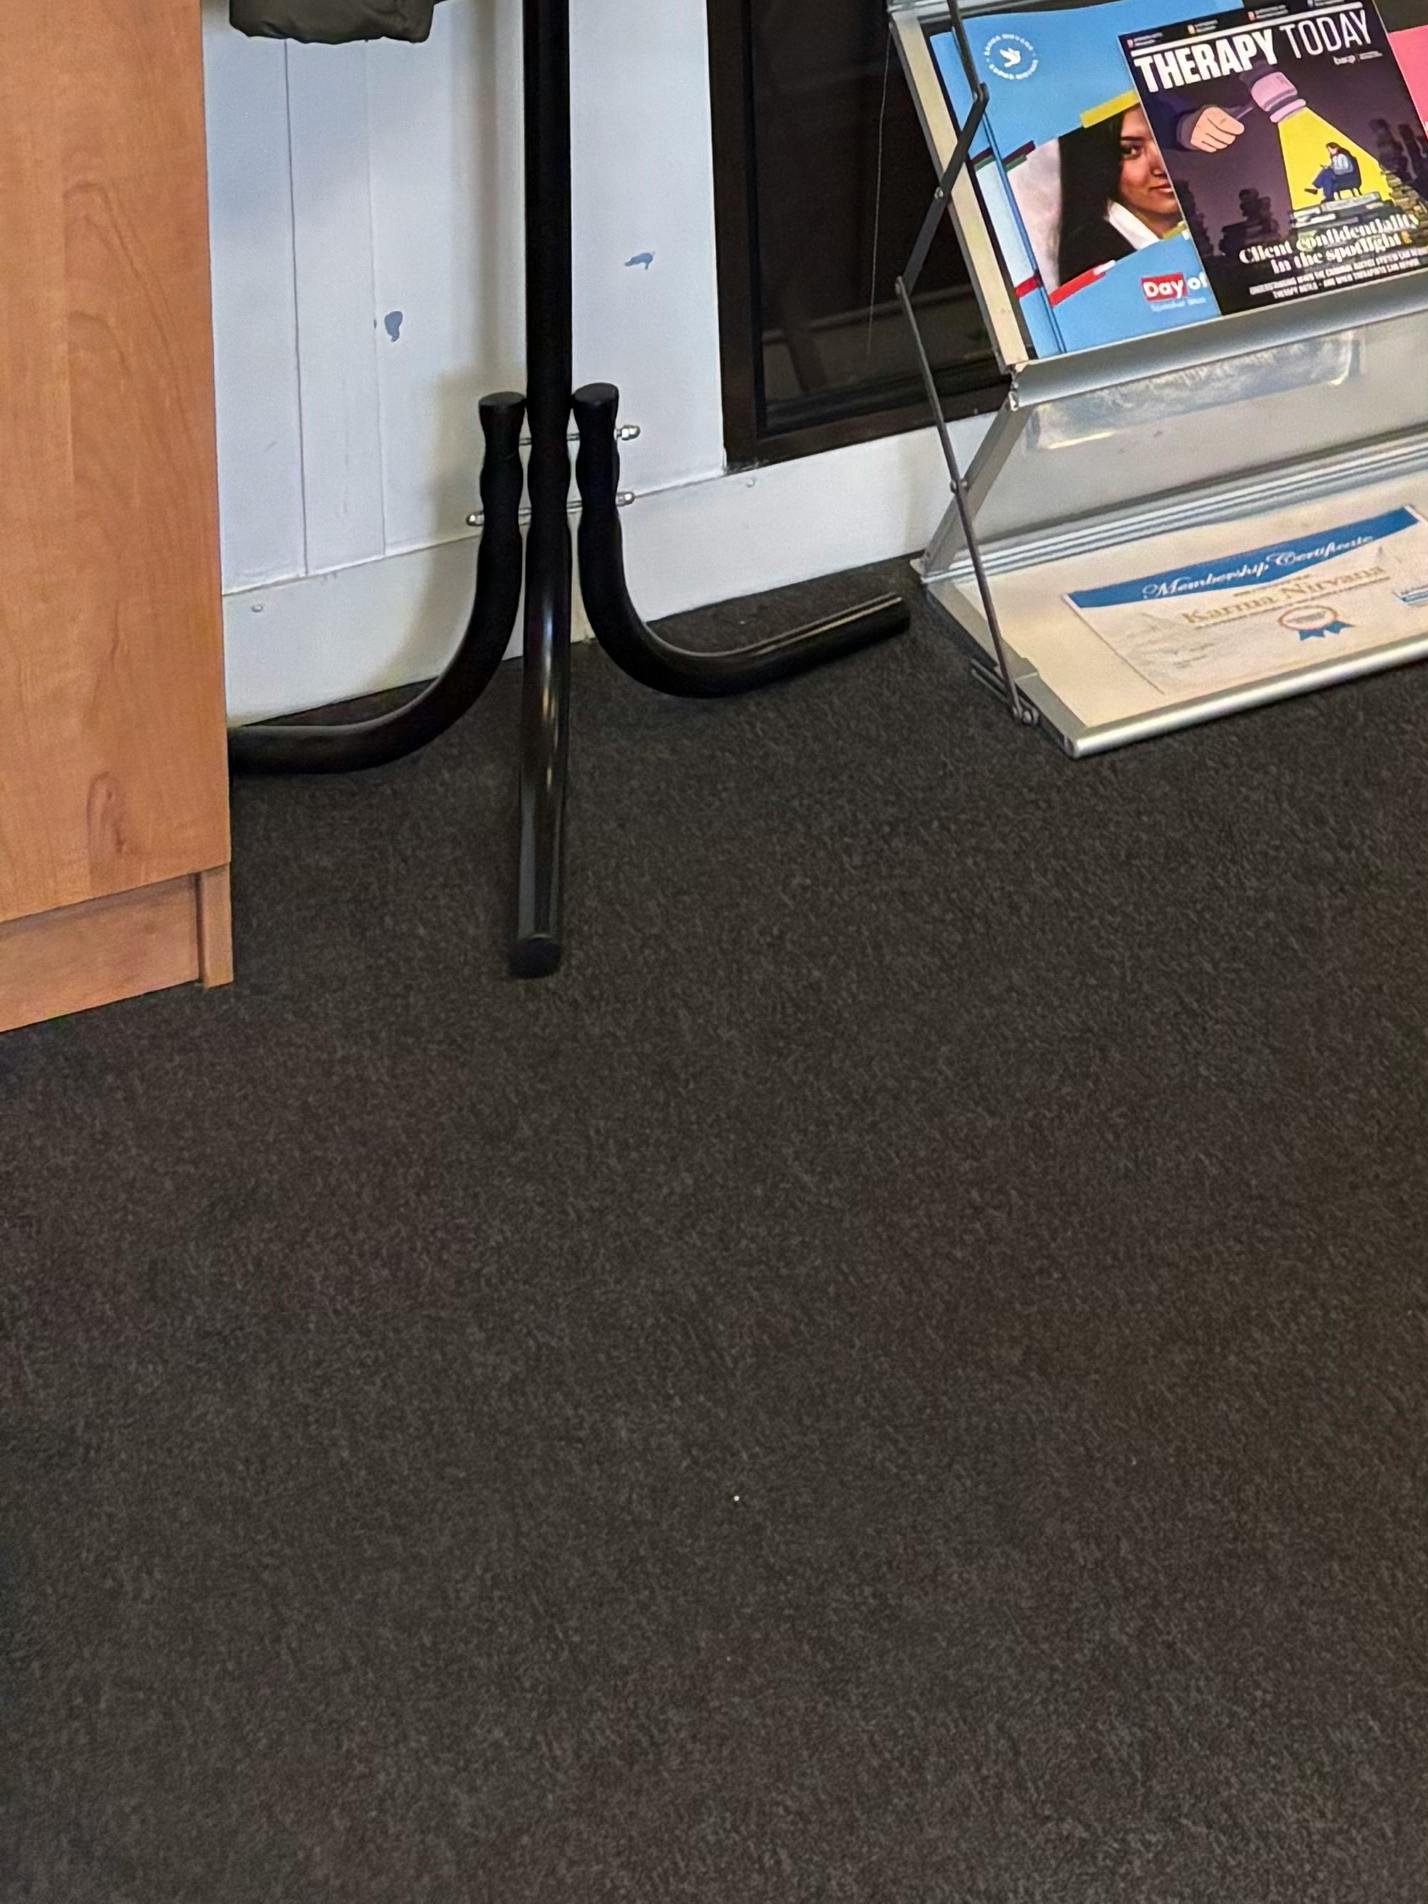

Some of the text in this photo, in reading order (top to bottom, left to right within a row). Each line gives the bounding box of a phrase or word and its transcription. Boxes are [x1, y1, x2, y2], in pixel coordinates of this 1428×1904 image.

[1133, 28, 1278, 94] THERAPY
[1279, 8, 1372, 59] TODAY
[1238, 212, 1421, 265] Client confidentiality
[1270, 230, 1402, 274] in the spotlight
[1143, 279, 1184, 299] Day
[1142, 535, 1375, 600] Membership Certificate
[1182, 593, 1276, 626] Karma
[1282, 564, 1386, 599] Nirvana
